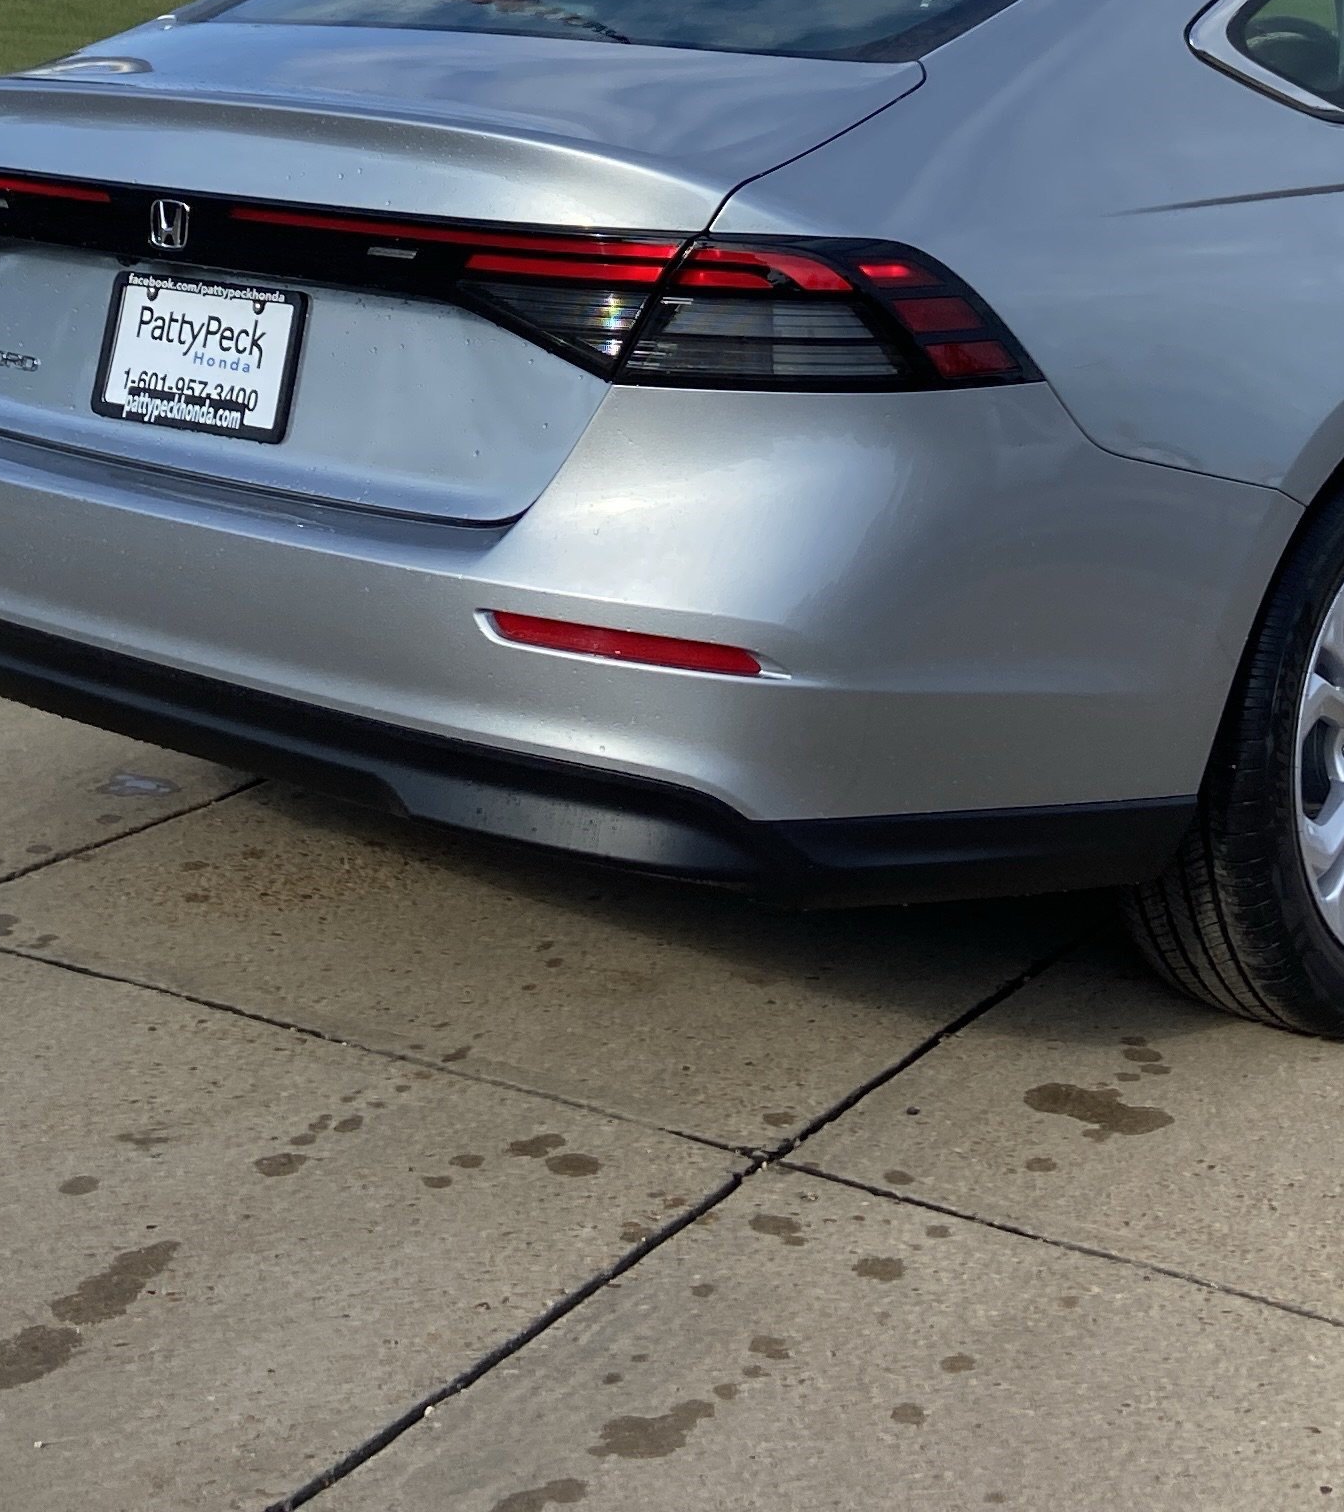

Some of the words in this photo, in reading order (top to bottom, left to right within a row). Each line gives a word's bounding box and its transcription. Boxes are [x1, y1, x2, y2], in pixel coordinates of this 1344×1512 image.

[128, 273, 286, 303] facebook.com/pattypeckhonda
[192, 351, 251, 374] Honda
[122, 392, 242, 430] pattypeckhonda.com
